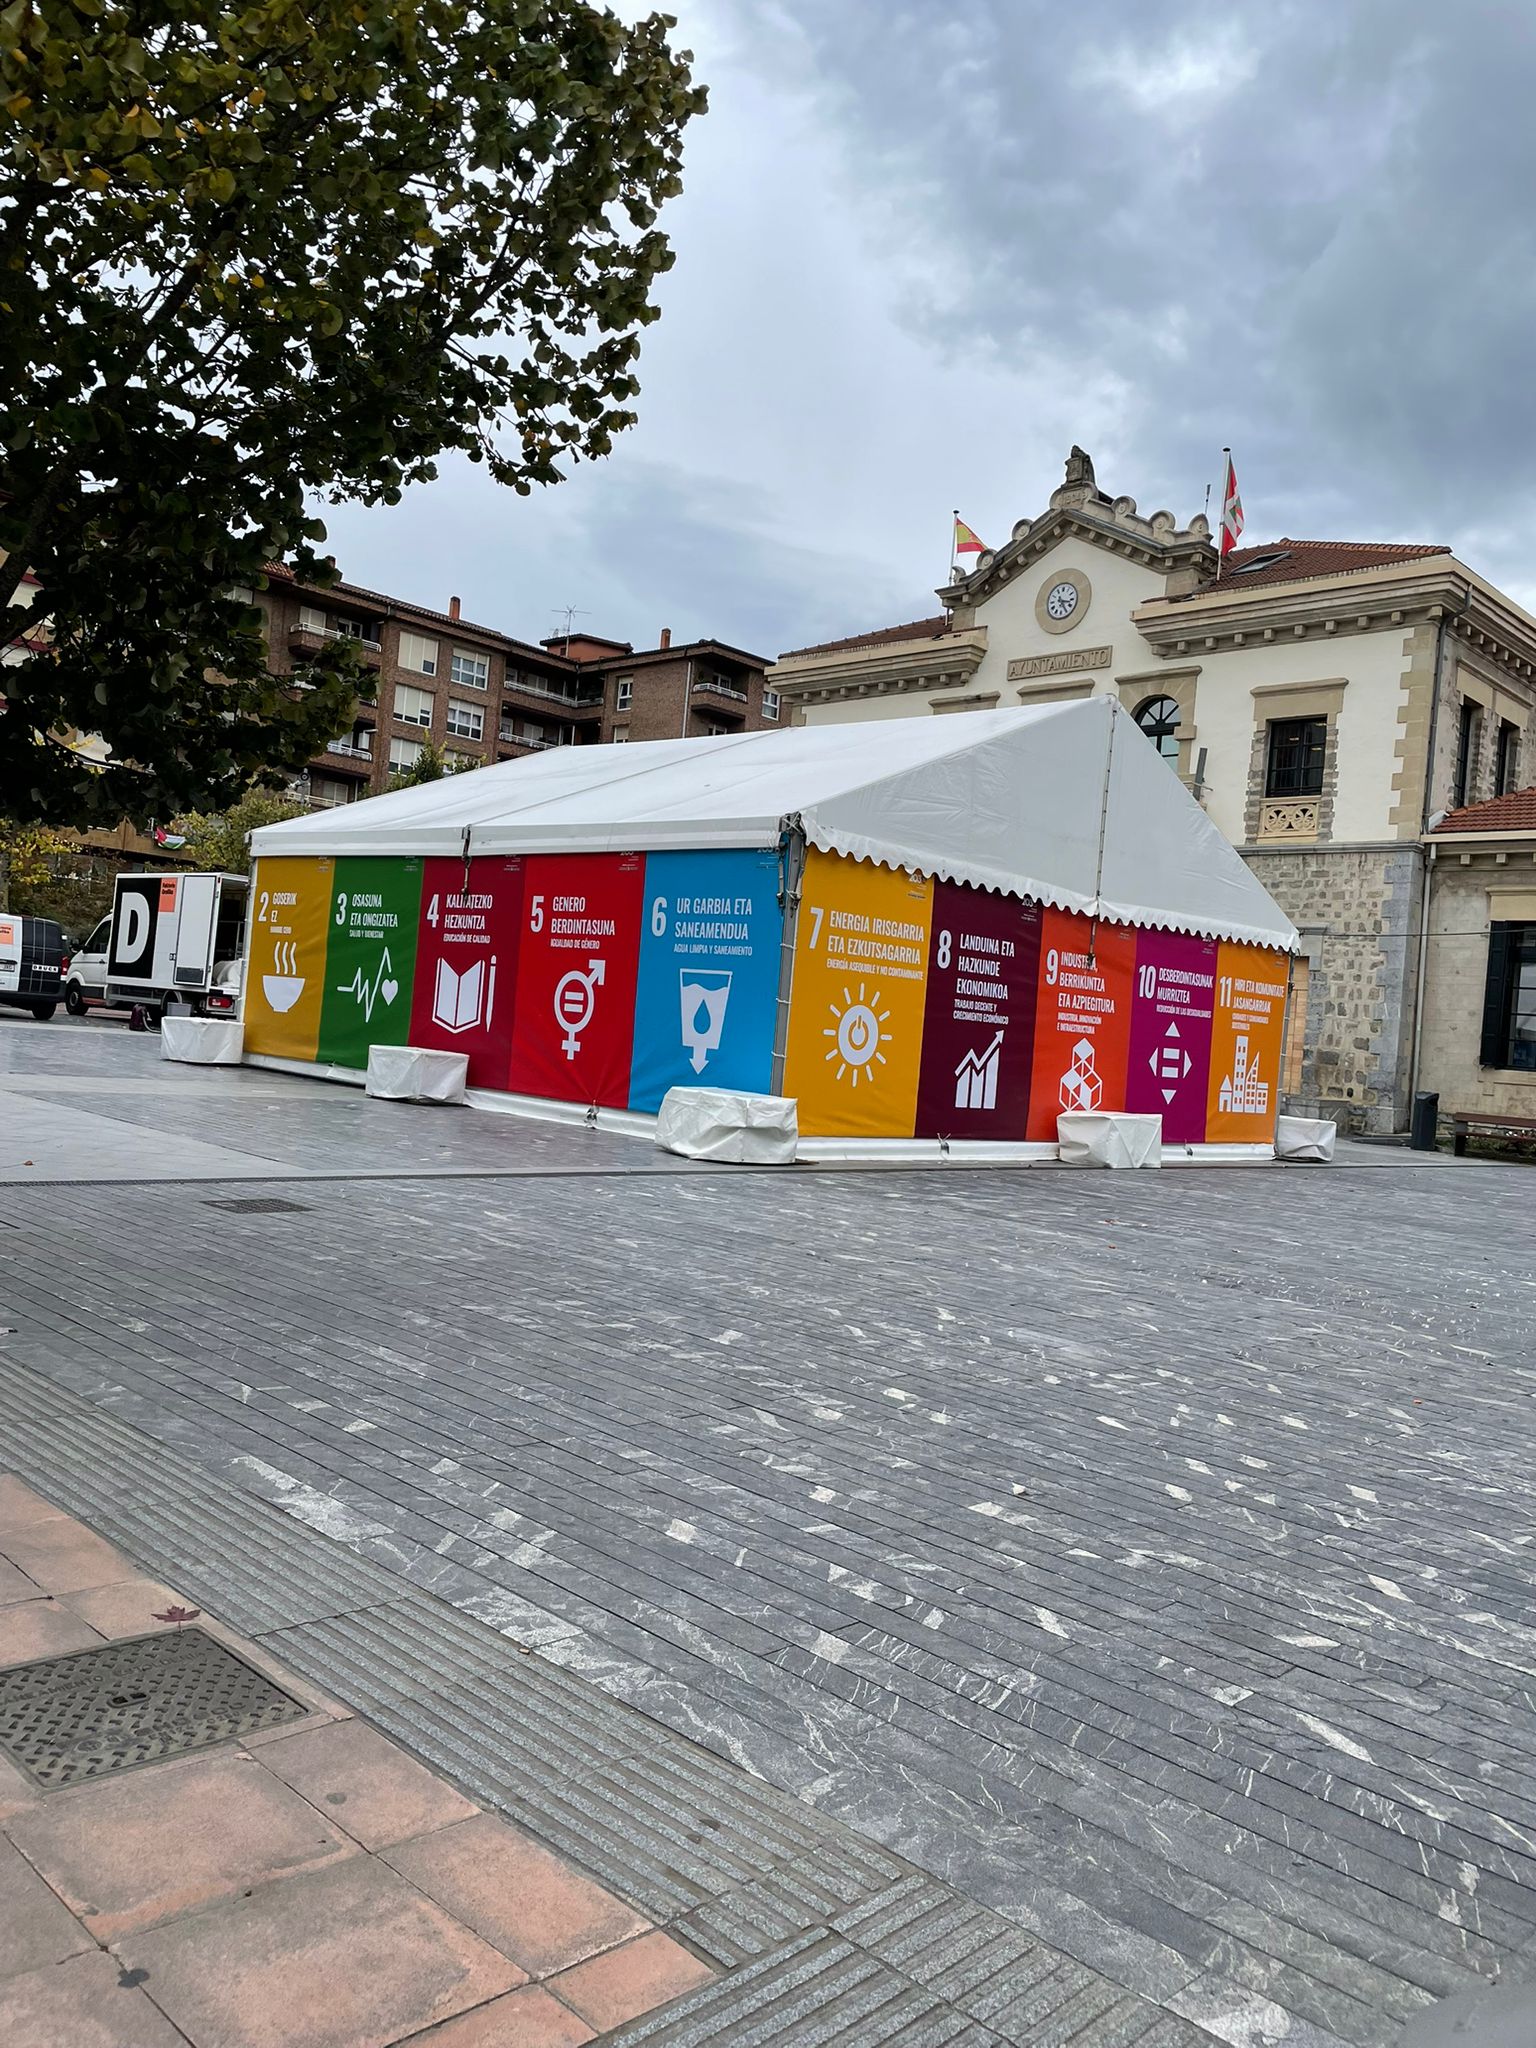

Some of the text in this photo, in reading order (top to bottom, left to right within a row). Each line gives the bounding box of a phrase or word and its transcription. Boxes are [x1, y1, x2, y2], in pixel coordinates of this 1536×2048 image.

[1009, 650, 1108, 677] AYUNTAMIENTO
[258, 891, 270, 923] 2
[335, 892, 347, 926] 3
[351, 894, 382, 908] OSASUNA
[426, 893, 439, 928] 4
[552, 896, 586, 913] GENERO
[676, 897, 752, 916] UR GARBIA ETA
[270, 910, 278, 923] EZ
[349, 913, 398, 928] ETA ONGIZATEA
[444, 914, 486, 930] HEZKUNTZA
[530, 895, 545, 933] 5
[651, 896, 667, 937] 6
[115, 892, 150, 964] D
[550, 918, 616, 936] BERDINTASUNA
[674, 921, 749, 940] SANEAMENDUA
[809, 906, 824, 949] 7
[829, 910, 924, 942] ENERGIA IRISGARRIA
[467, 934, 472, 943] DE
[550, 937, 600, 950] IGUALDAD DE GÉNERO
[673, 943, 753, 956] AGUA LIMPIA Y SANEAMIENTO
[937, 929, 952, 969] 8
[959, 933, 1015, 958] LANDUINA ETA
[827, 935, 921, 965] ETA EZKUTSAGARRIA
[826, 957, 849, 971] ENERGÍA
[876, 965, 880, 975] Y
[880, 966, 888, 976] NO
[957, 955, 1000, 977] HAZKUNDE
[1045, 948, 1059, 985] 9
[956, 978, 1009, 1000] EKONOMIKOA
[1059, 972, 1106, 993] BERRIKUNTZA
[1138, 963, 1157, 999] 10
[1158, 967, 1214, 989] DESBERDINTASUNAK
[1058, 992, 1115, 1014] ETA AZPIEGITURA
[1156, 987, 1191, 1004] MURRIZTEA
[1219, 976, 1232, 1008] 11
[954, 999, 974, 1010] TRABAJO
[993, 1003, 998, 1012] Y
